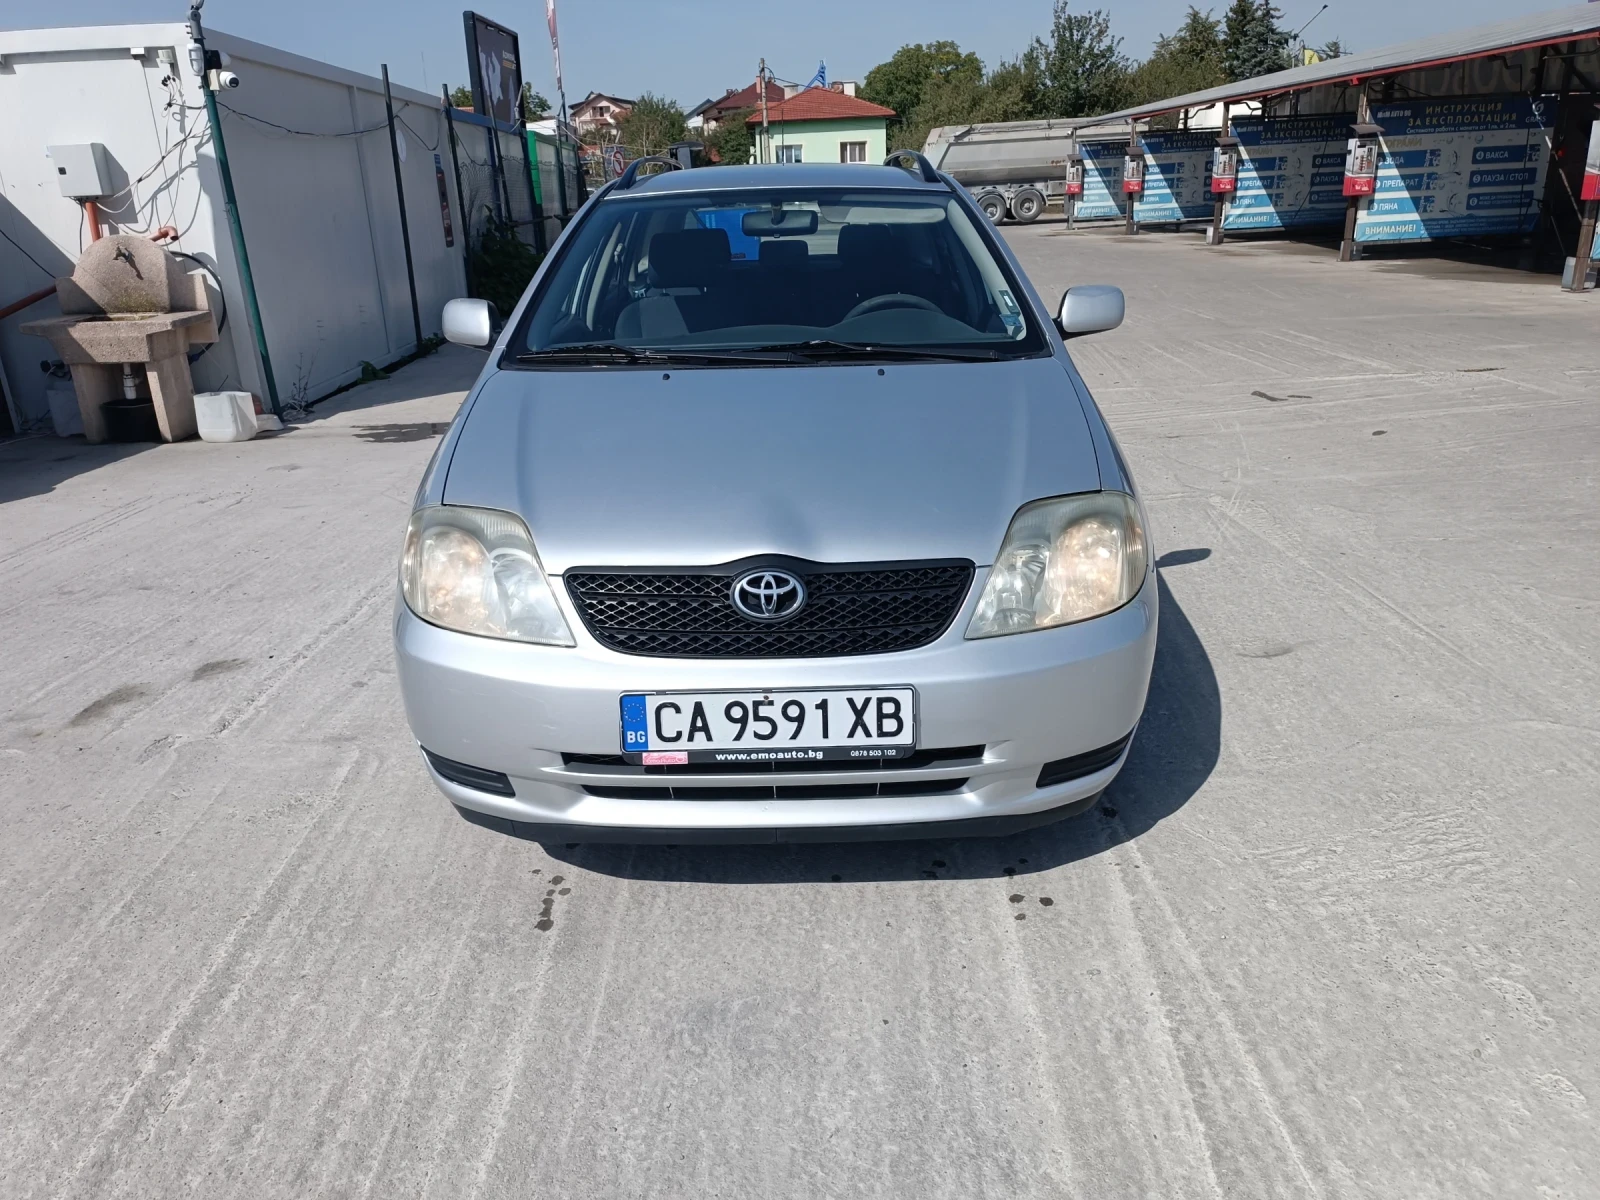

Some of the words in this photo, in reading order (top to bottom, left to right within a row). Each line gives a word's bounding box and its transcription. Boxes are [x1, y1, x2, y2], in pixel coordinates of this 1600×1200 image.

[1425, 102, 1502, 114] ИНСТРУКЦИЯ
[1408, 117, 1422, 126] ЗА
[1425, 112, 1517, 125] ЕКСПЛОАТАЦИЯ
[1485, 151, 1509, 159] ВАКСА
[1482, 173, 1504, 182] ПАУЗА
[1509, 172, 1528, 181] СТОП
[1382, 178, 1419, 188] ПРЕПАРАТ
[1379, 202, 1398, 211] ПЯНА
[1365, 224, 1416, 234] ВНИМАНИЕ!
[654, 701, 714, 743] CA
[724, 698, 829, 742] 9591
[846, 696, 904, 738] XB
[627, 731, 646, 743] BG
[715, 750, 824, 761] www.emoauto.bg
